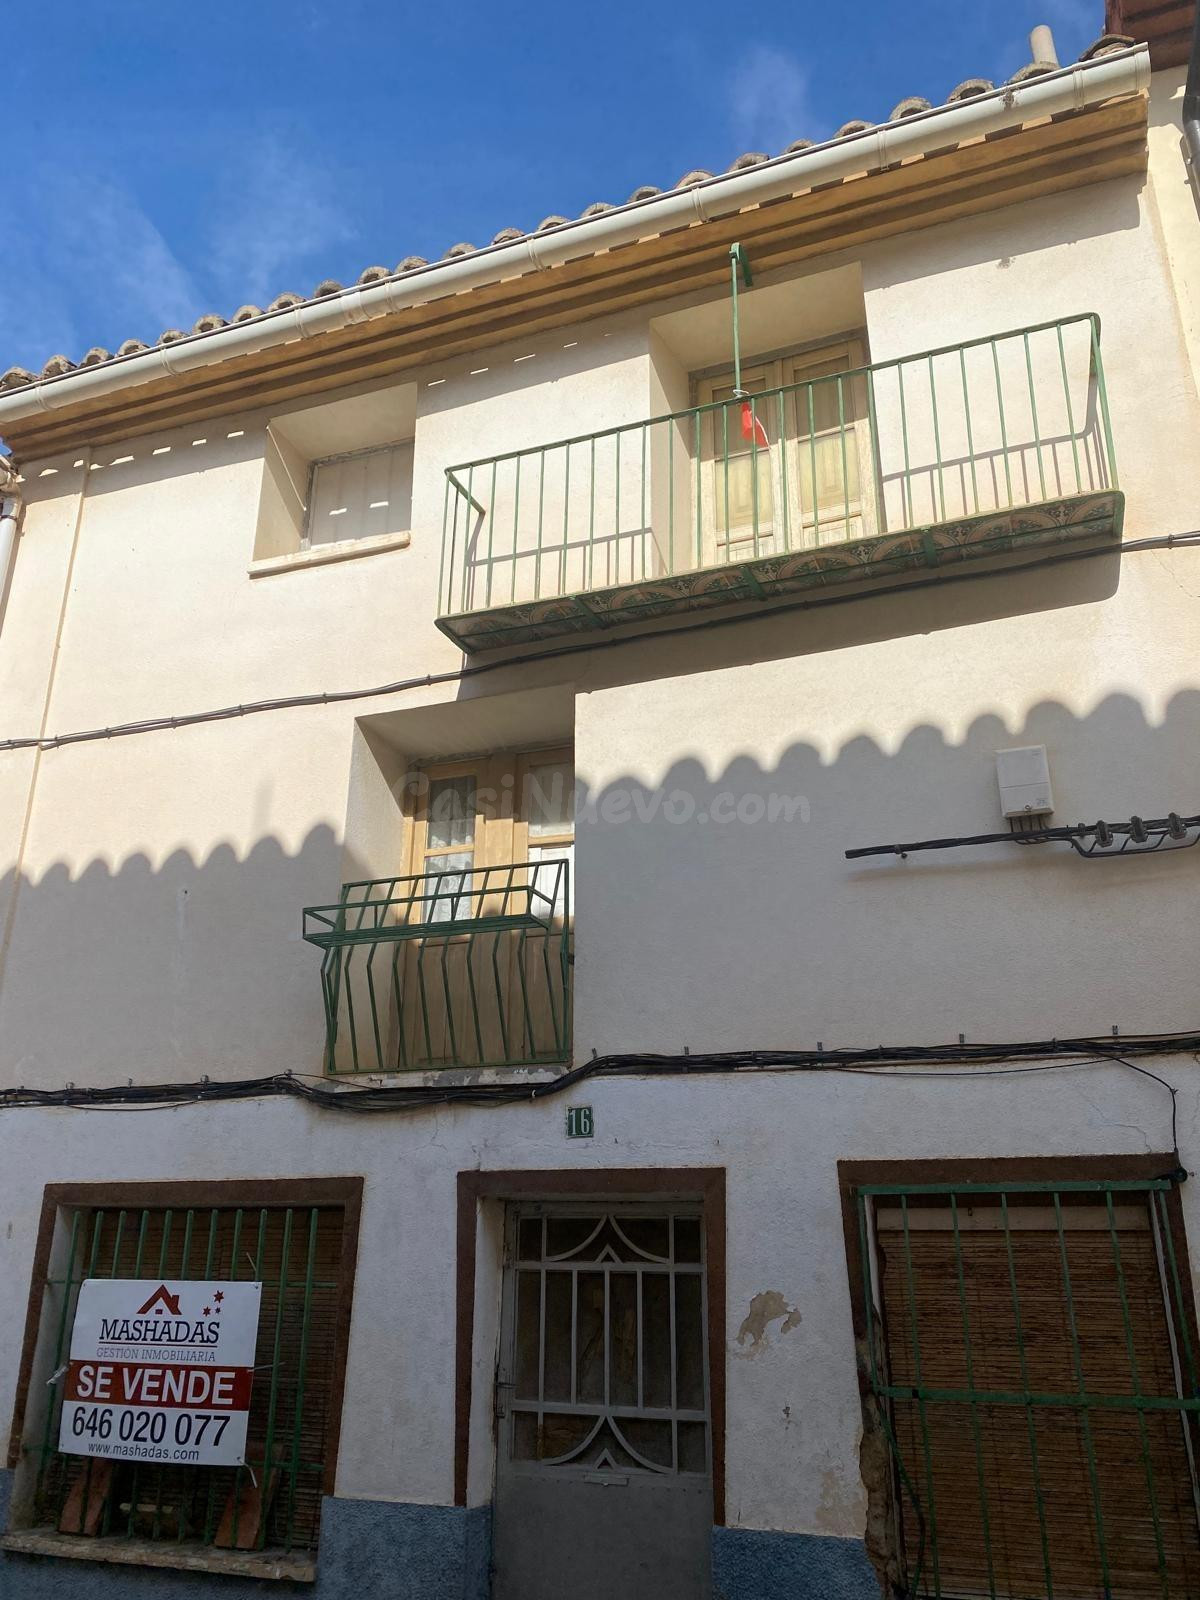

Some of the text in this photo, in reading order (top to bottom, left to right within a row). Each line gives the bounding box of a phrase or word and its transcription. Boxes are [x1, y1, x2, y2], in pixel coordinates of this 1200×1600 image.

[569, 1108, 590, 1134] 16
[99, 1319, 220, 1343] MASHADAS
[141, 1349, 216, 1362] INMOBILIARIA
[77, 1365, 236, 1405] SE VENDE
[72, 1407, 231, 1447] 646 020 077
[88, 1442, 200, 1461] www.mashadas.com
